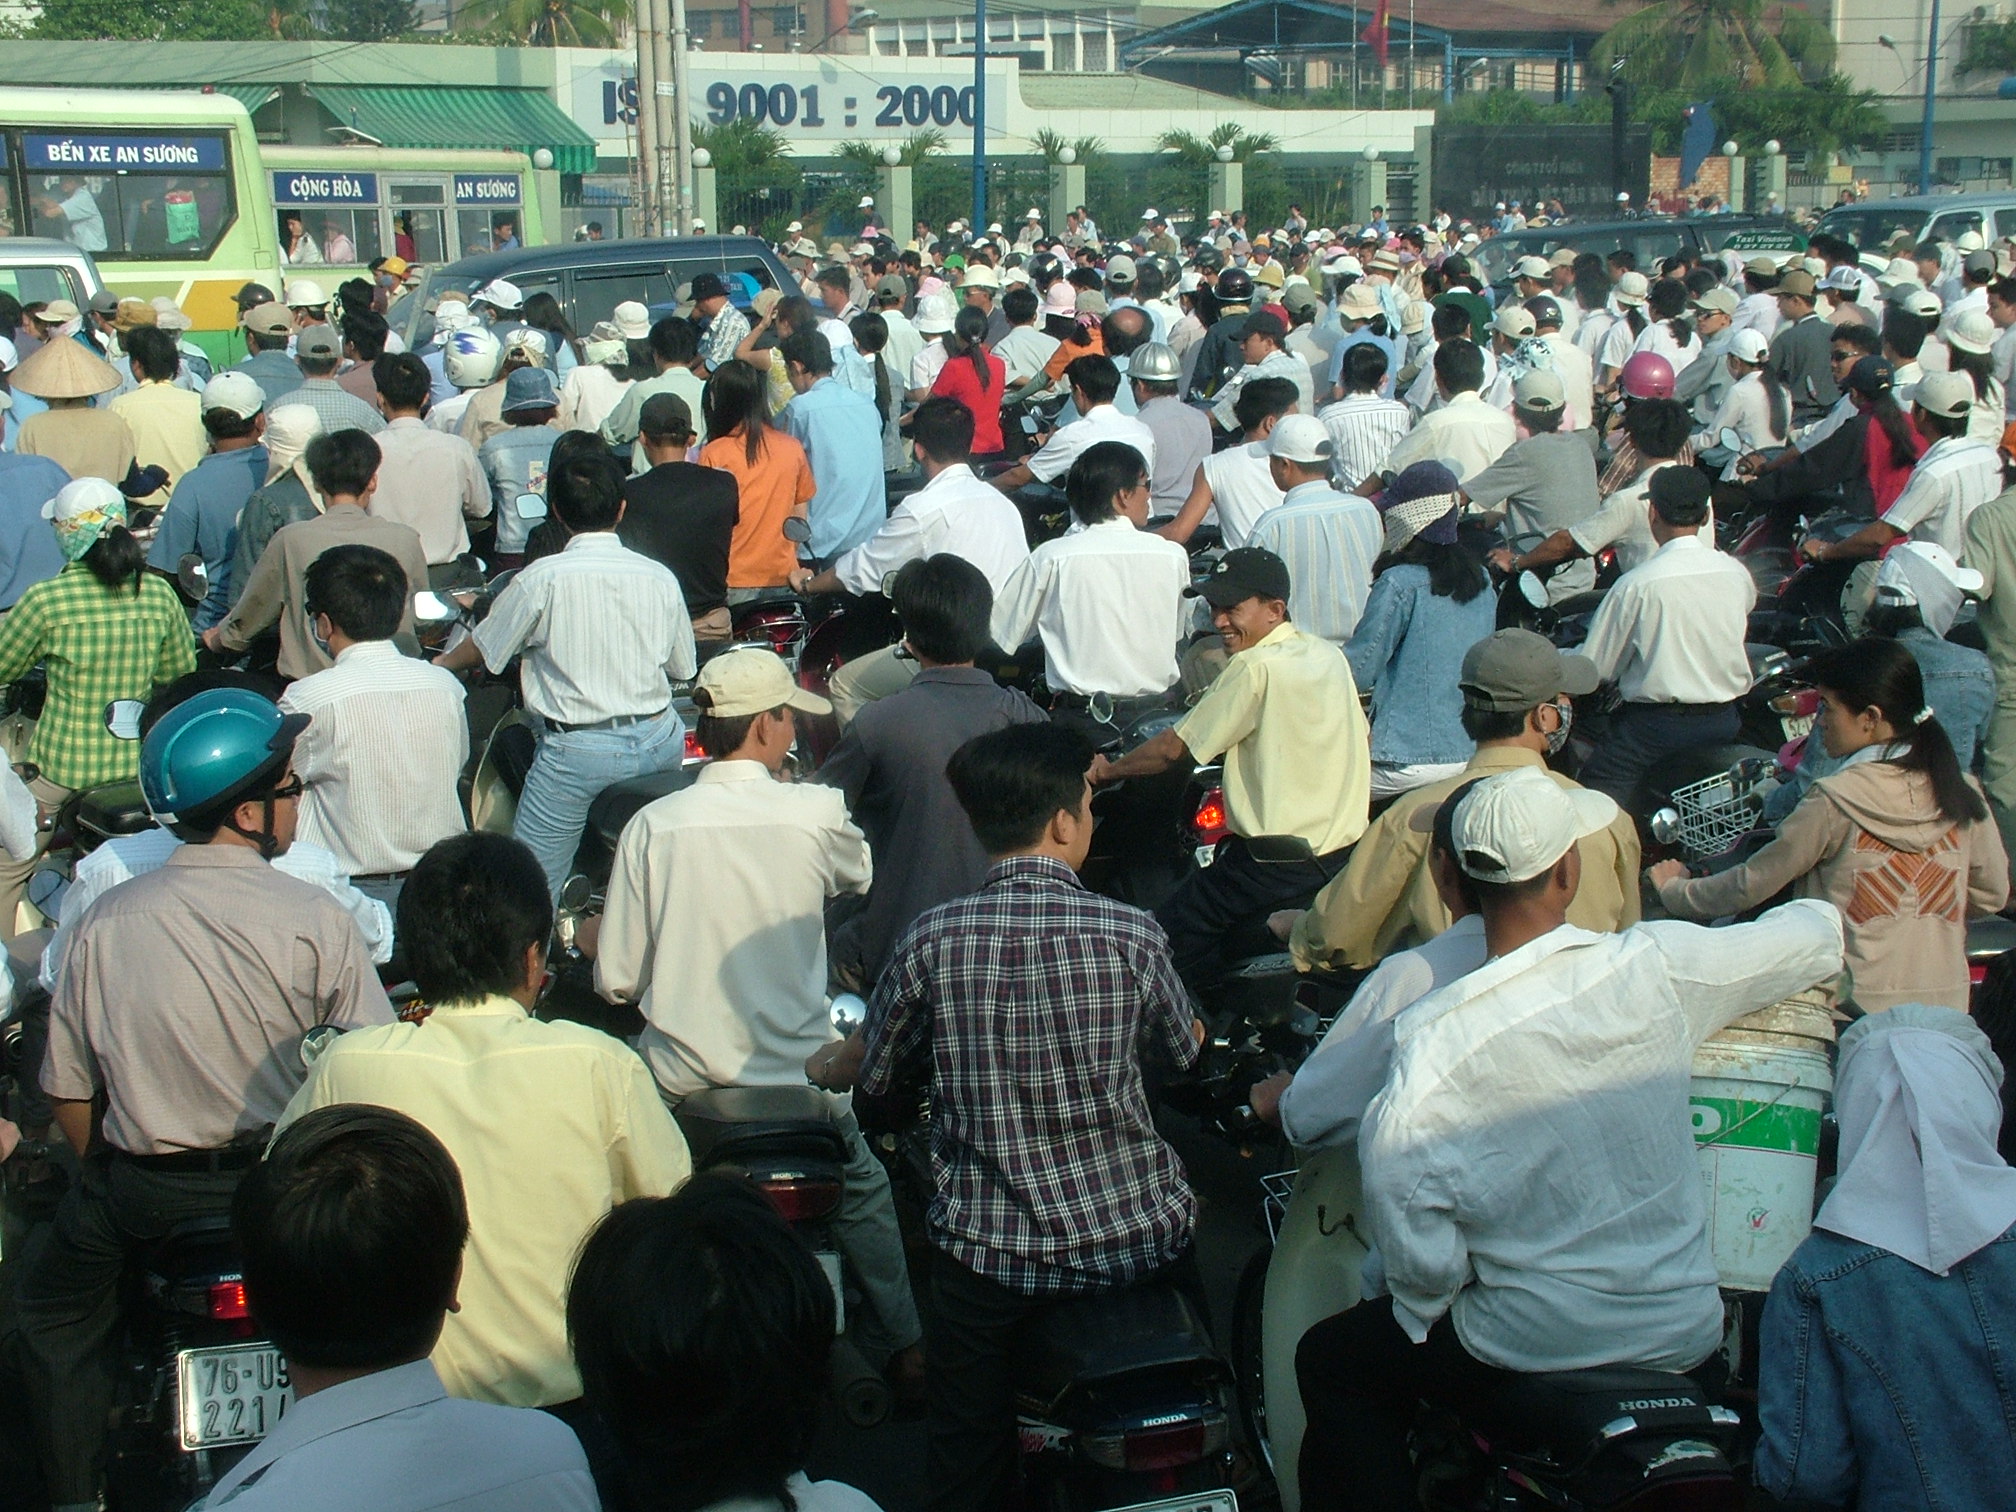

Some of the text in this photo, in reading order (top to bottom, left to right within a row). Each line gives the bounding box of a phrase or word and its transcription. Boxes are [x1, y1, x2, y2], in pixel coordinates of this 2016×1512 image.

[602, 79, 975, 128] IS 9001 : 2000
[47, 139, 199, 163] BẾN XE AN SƯƠNG
[290, 175, 363, 201] CỘNG HÒA
[456, 178, 517, 198] AN SƯƠNG
[1736, 235, 1755, 243] Taxi
[219, 1273, 243, 1282] HON
[1619, 1397, 1697, 1411] HONDA
[1142, 1413, 1188, 1427] HONDA
